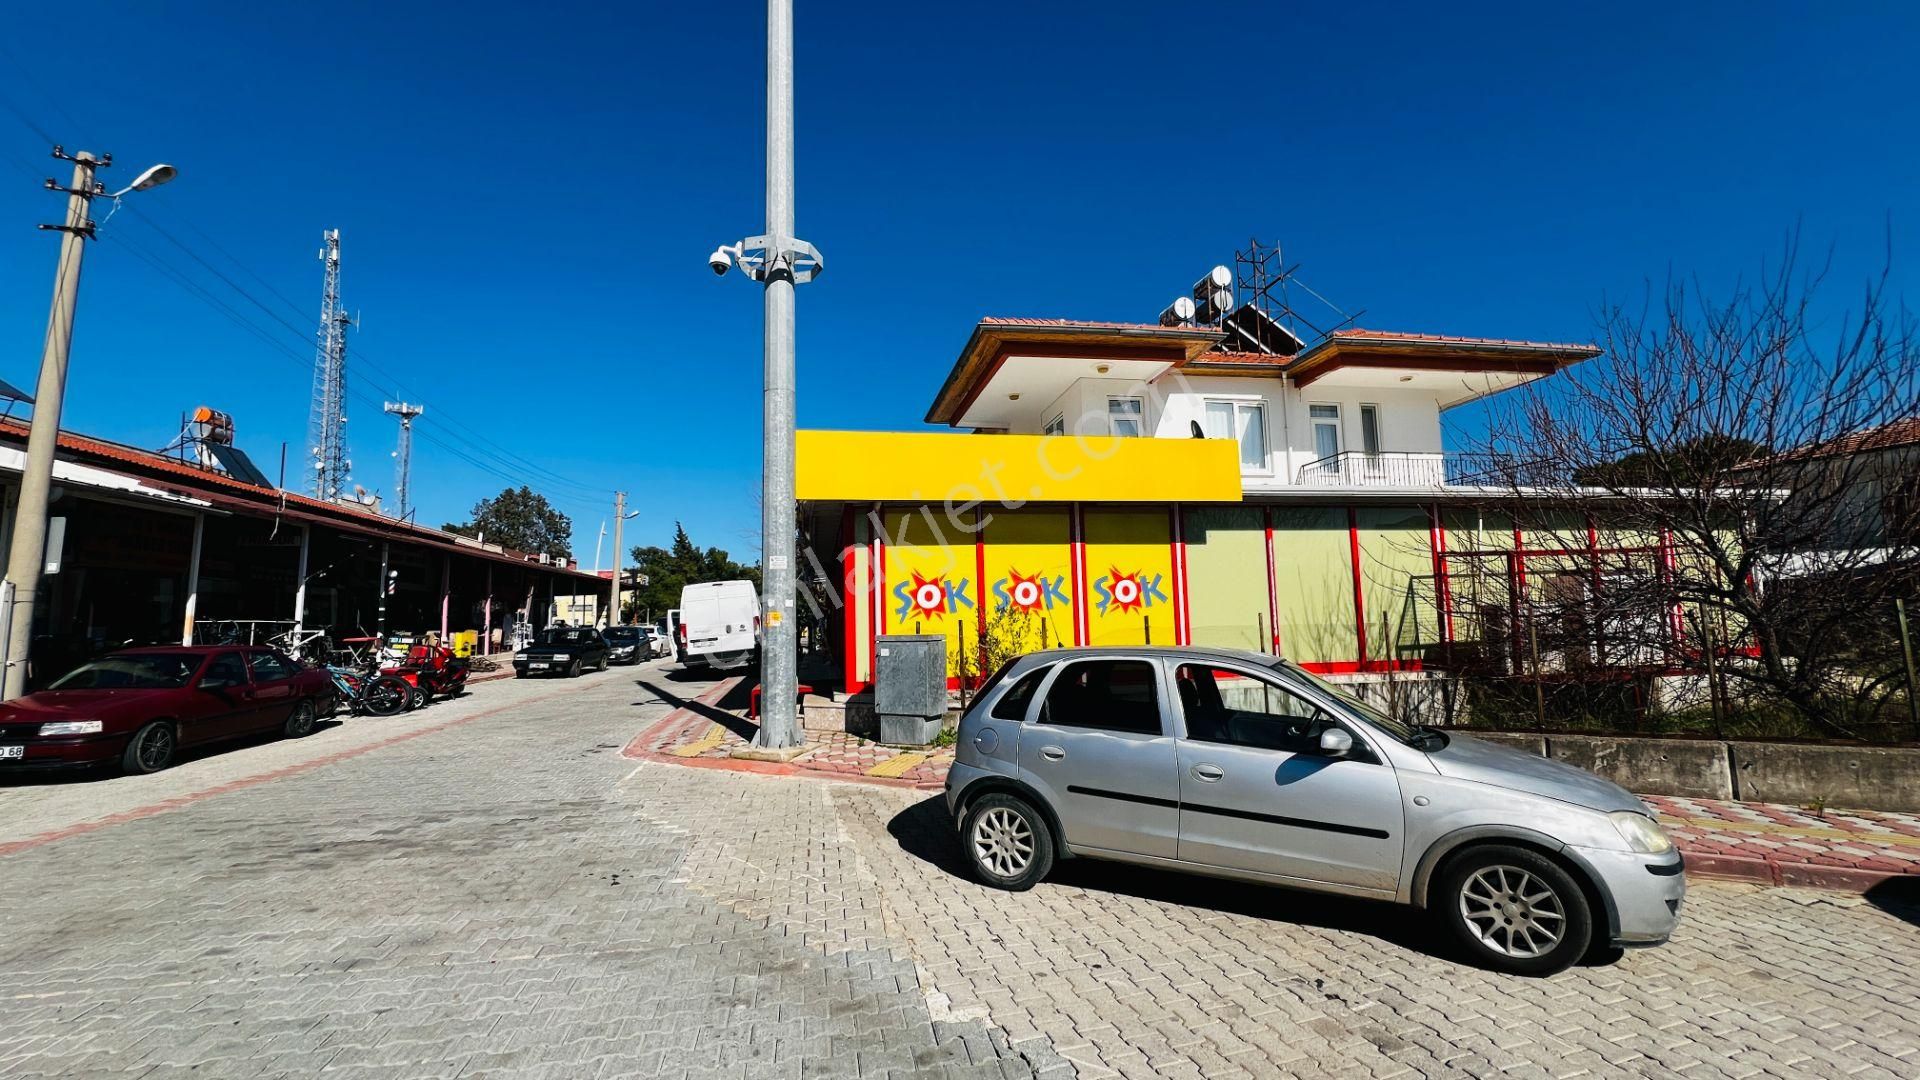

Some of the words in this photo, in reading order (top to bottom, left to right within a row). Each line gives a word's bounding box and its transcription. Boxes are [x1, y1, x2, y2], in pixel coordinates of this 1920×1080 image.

[893, 577, 974, 624] ŞOK
[1093, 573, 1168, 618] ŞOK
[9, 747, 22, 756] 68
